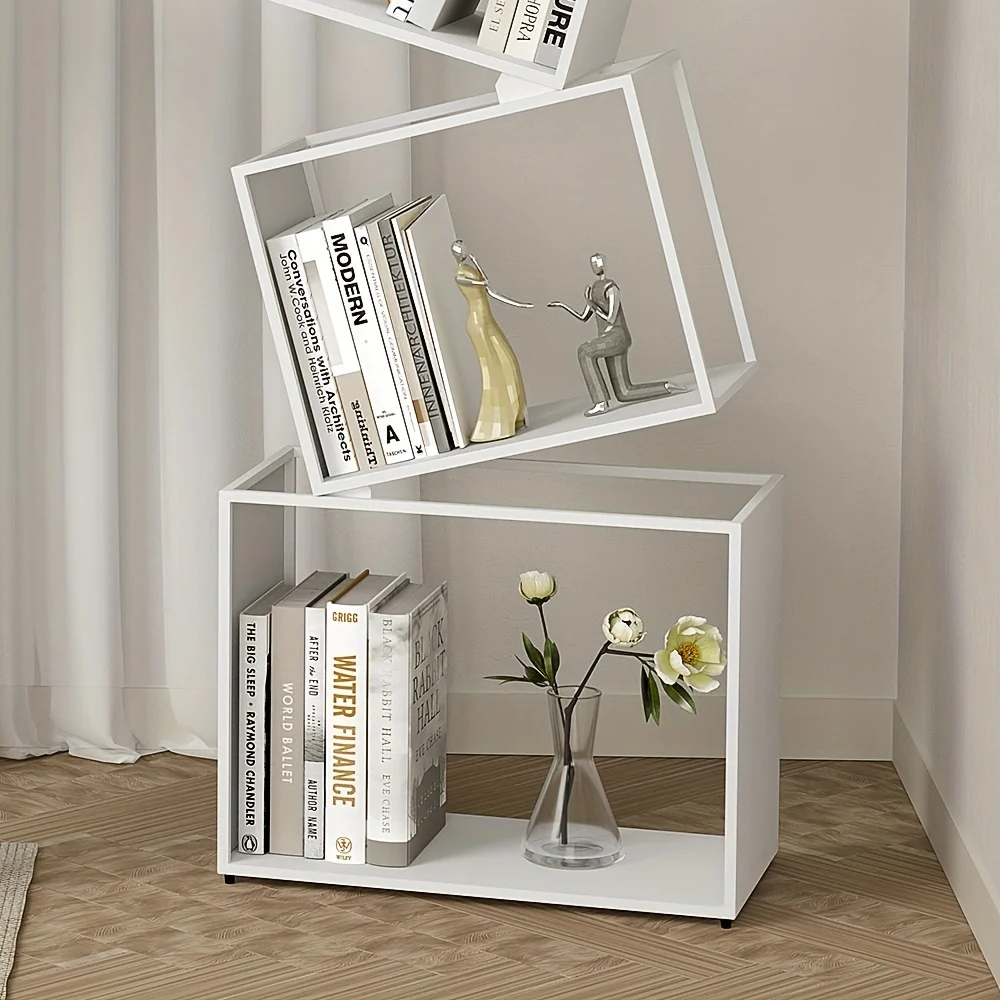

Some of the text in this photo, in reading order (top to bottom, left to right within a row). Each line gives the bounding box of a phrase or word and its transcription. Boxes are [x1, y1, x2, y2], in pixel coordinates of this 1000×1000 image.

[489, 18, 501, 33] EL
[331, 232, 368, 327] MODERN
[279, 253, 293, 281] John
[301, 331, 313, 354] and
[308, 357, 327, 404] Heinrich
[322, 405, 334, 433] Klotz
[287, 250, 351, 462] Conversations with Architects
[382, 234, 440, 420] INNENARCHITEKTUR
[387, 425, 400, 444] A
[309, 636, 318, 661] AFTER
[332, 611, 358, 622] GRIGG
[414, 618, 444, 669] BLCK
[245, 622, 256, 826] THE BIG SLEEP RAYMOND CHANDLER
[309, 680, 318, 696] END
[381, 619, 392, 833] BLACK RABBIT HALL EVE CHASE
[417, 689, 440, 734] HALL
[281, 682, 294, 784] WORLD BALLET
[332, 655, 356, 808] WATER FINANCE
[307, 779, 318, 840] AUTHOR NAME
